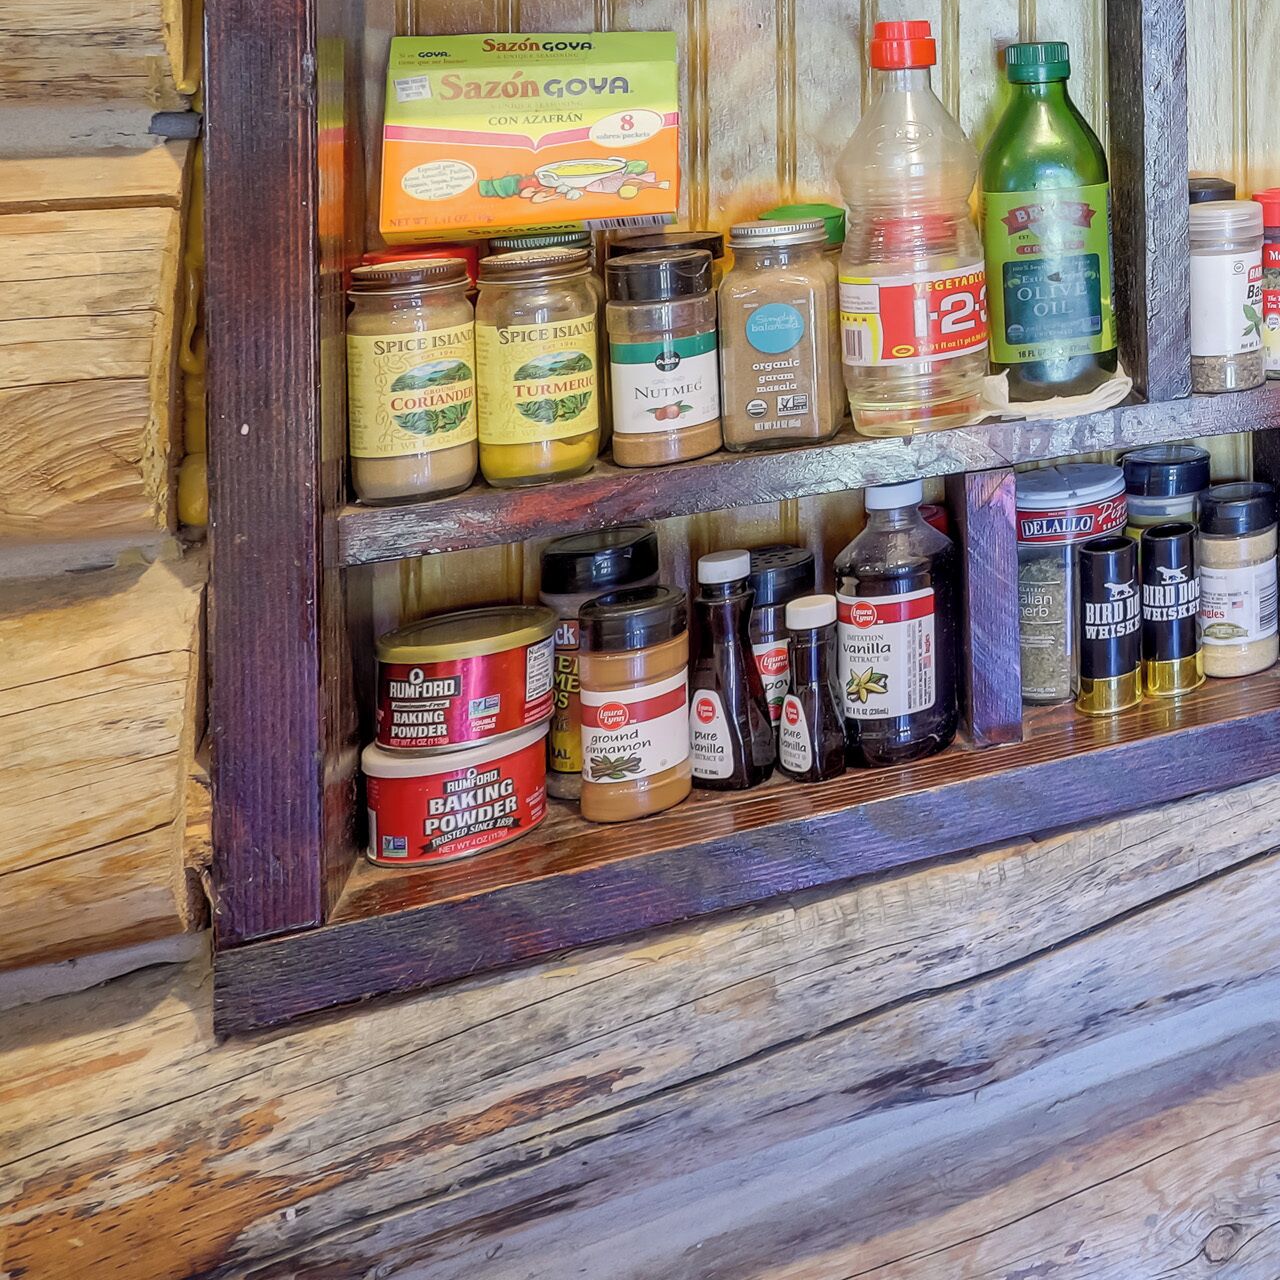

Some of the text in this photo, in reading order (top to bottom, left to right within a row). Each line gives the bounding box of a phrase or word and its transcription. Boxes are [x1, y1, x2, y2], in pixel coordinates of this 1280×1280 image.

[482, 38, 592, 52] Sazón GOYA
[440, 71, 539, 100] Sazón
[543, 76, 629, 98] GOYA
[488, 112, 582, 126] CON AZAFRÁN
[620, 114, 634, 131] 8
[1017, 282, 1088, 301] OLIVE
[1034, 300, 1074, 317] OIL
[499, 328, 549, 345] SPICE
[374, 337, 426, 356] SPICE
[752, 359, 800, 371] organic
[759, 373, 794, 383] garam
[513, 376, 594, 398] TURMERIC
[634, 380, 702, 399] NUTMEG
[756, 383, 797, 393] masala
[391, 387, 473, 411] CORIANDER
[1025, 517, 1090, 536] DELALLO
[1143, 584, 1175, 606] BIRD
[1179, 577, 1199, 604] DOG
[1086, 603, 1123, 624] BIRD
[1143, 598, 1200, 621] WHISKEY
[1085, 617, 1140, 639] WHISKE
[843, 643, 891, 654] vanilla
[390, 679, 455, 698] RUMFORD
[393, 711, 444, 723] BAKING
[600, 709, 624, 718] Laura
[604, 716, 625, 726] Lynn
[391, 724, 447, 737] POWDER
[590, 729, 638, 746] ground
[695, 731, 717, 741] pure
[784, 728, 801, 739] pure
[585, 739, 651, 754] cinnamon
[691, 743, 724, 753] vanilla
[447, 770, 498, 793] RUMFORD
[430, 779, 512, 815] BAKING
[425, 796, 517, 835] POWDER
[432, 817, 513, 848] TRUSTED SINCE 1859
[439, 845, 456, 853] NET
